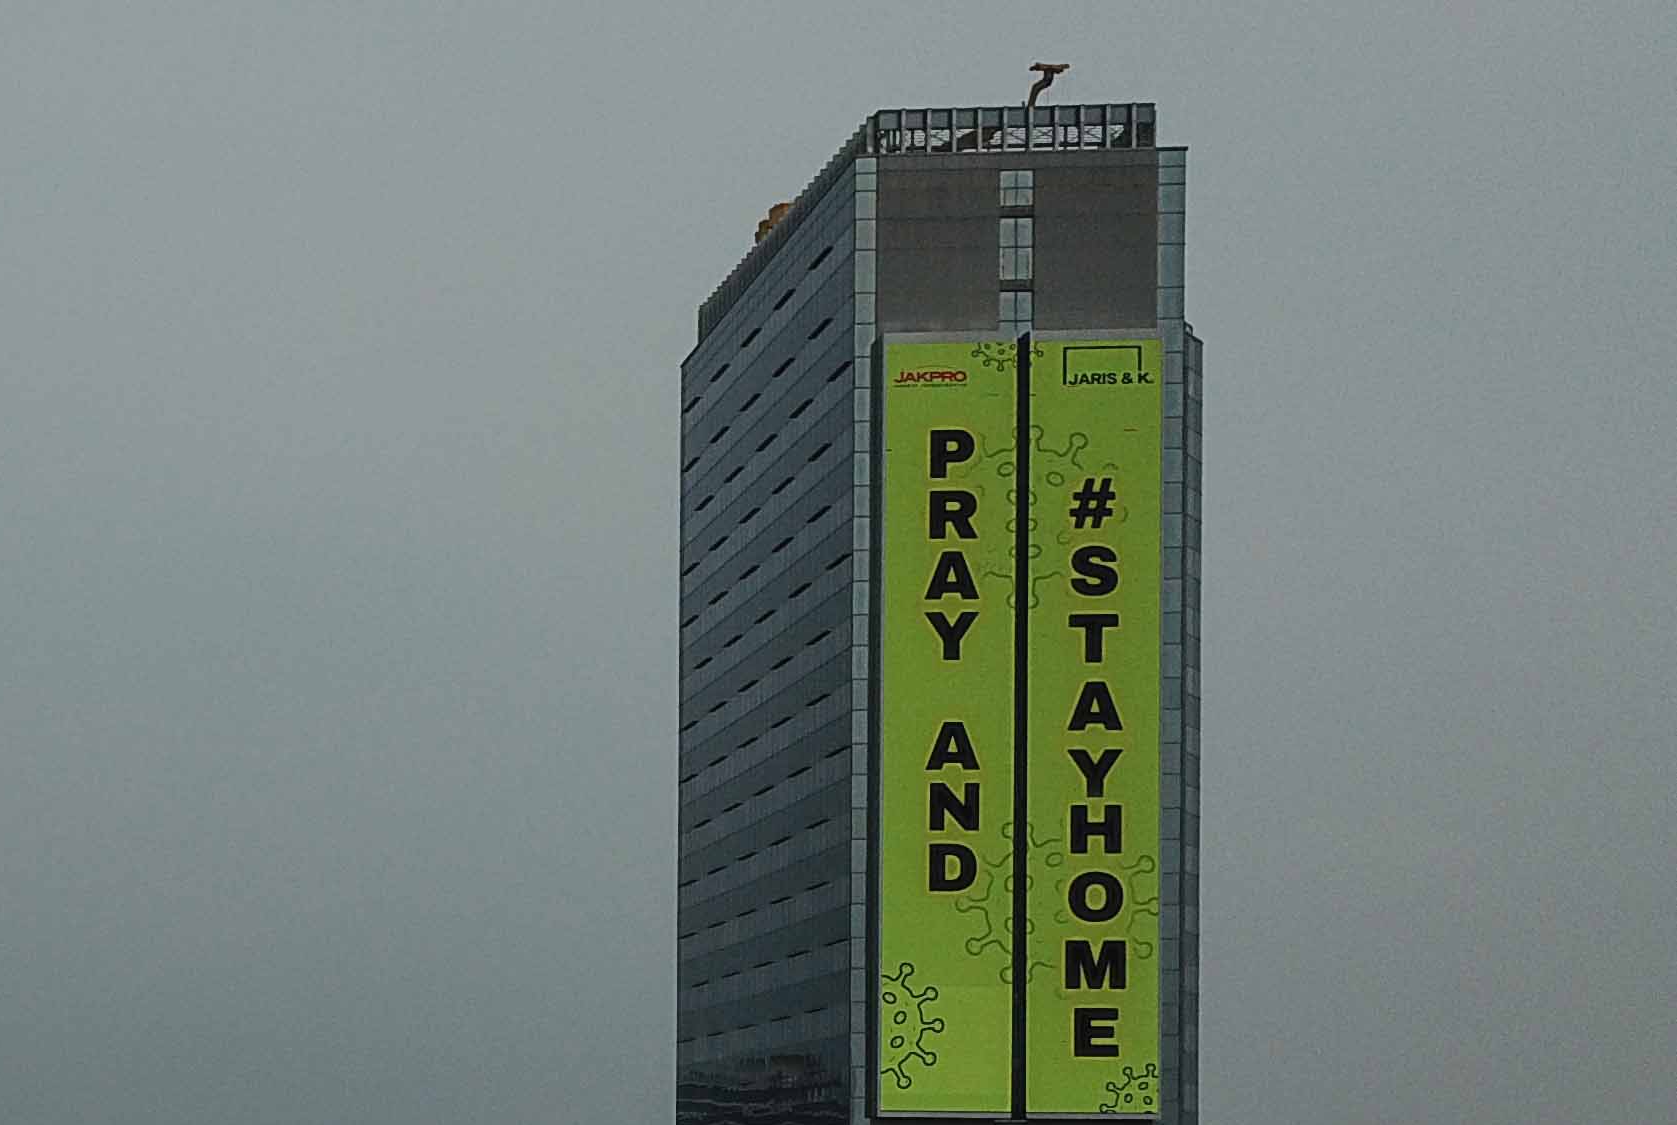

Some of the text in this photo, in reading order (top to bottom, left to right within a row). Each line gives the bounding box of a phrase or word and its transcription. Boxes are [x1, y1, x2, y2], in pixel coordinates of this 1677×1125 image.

[894, 371, 967, 383] JAKPRO
[1068, 372, 1117, 385] JARIS
[1121, 372, 1133, 385] &
[924, 429, 980, 661] PRAY
[925, 721, 980, 892] AND
[1065, 478, 1127, 1058] #STAYHOME
